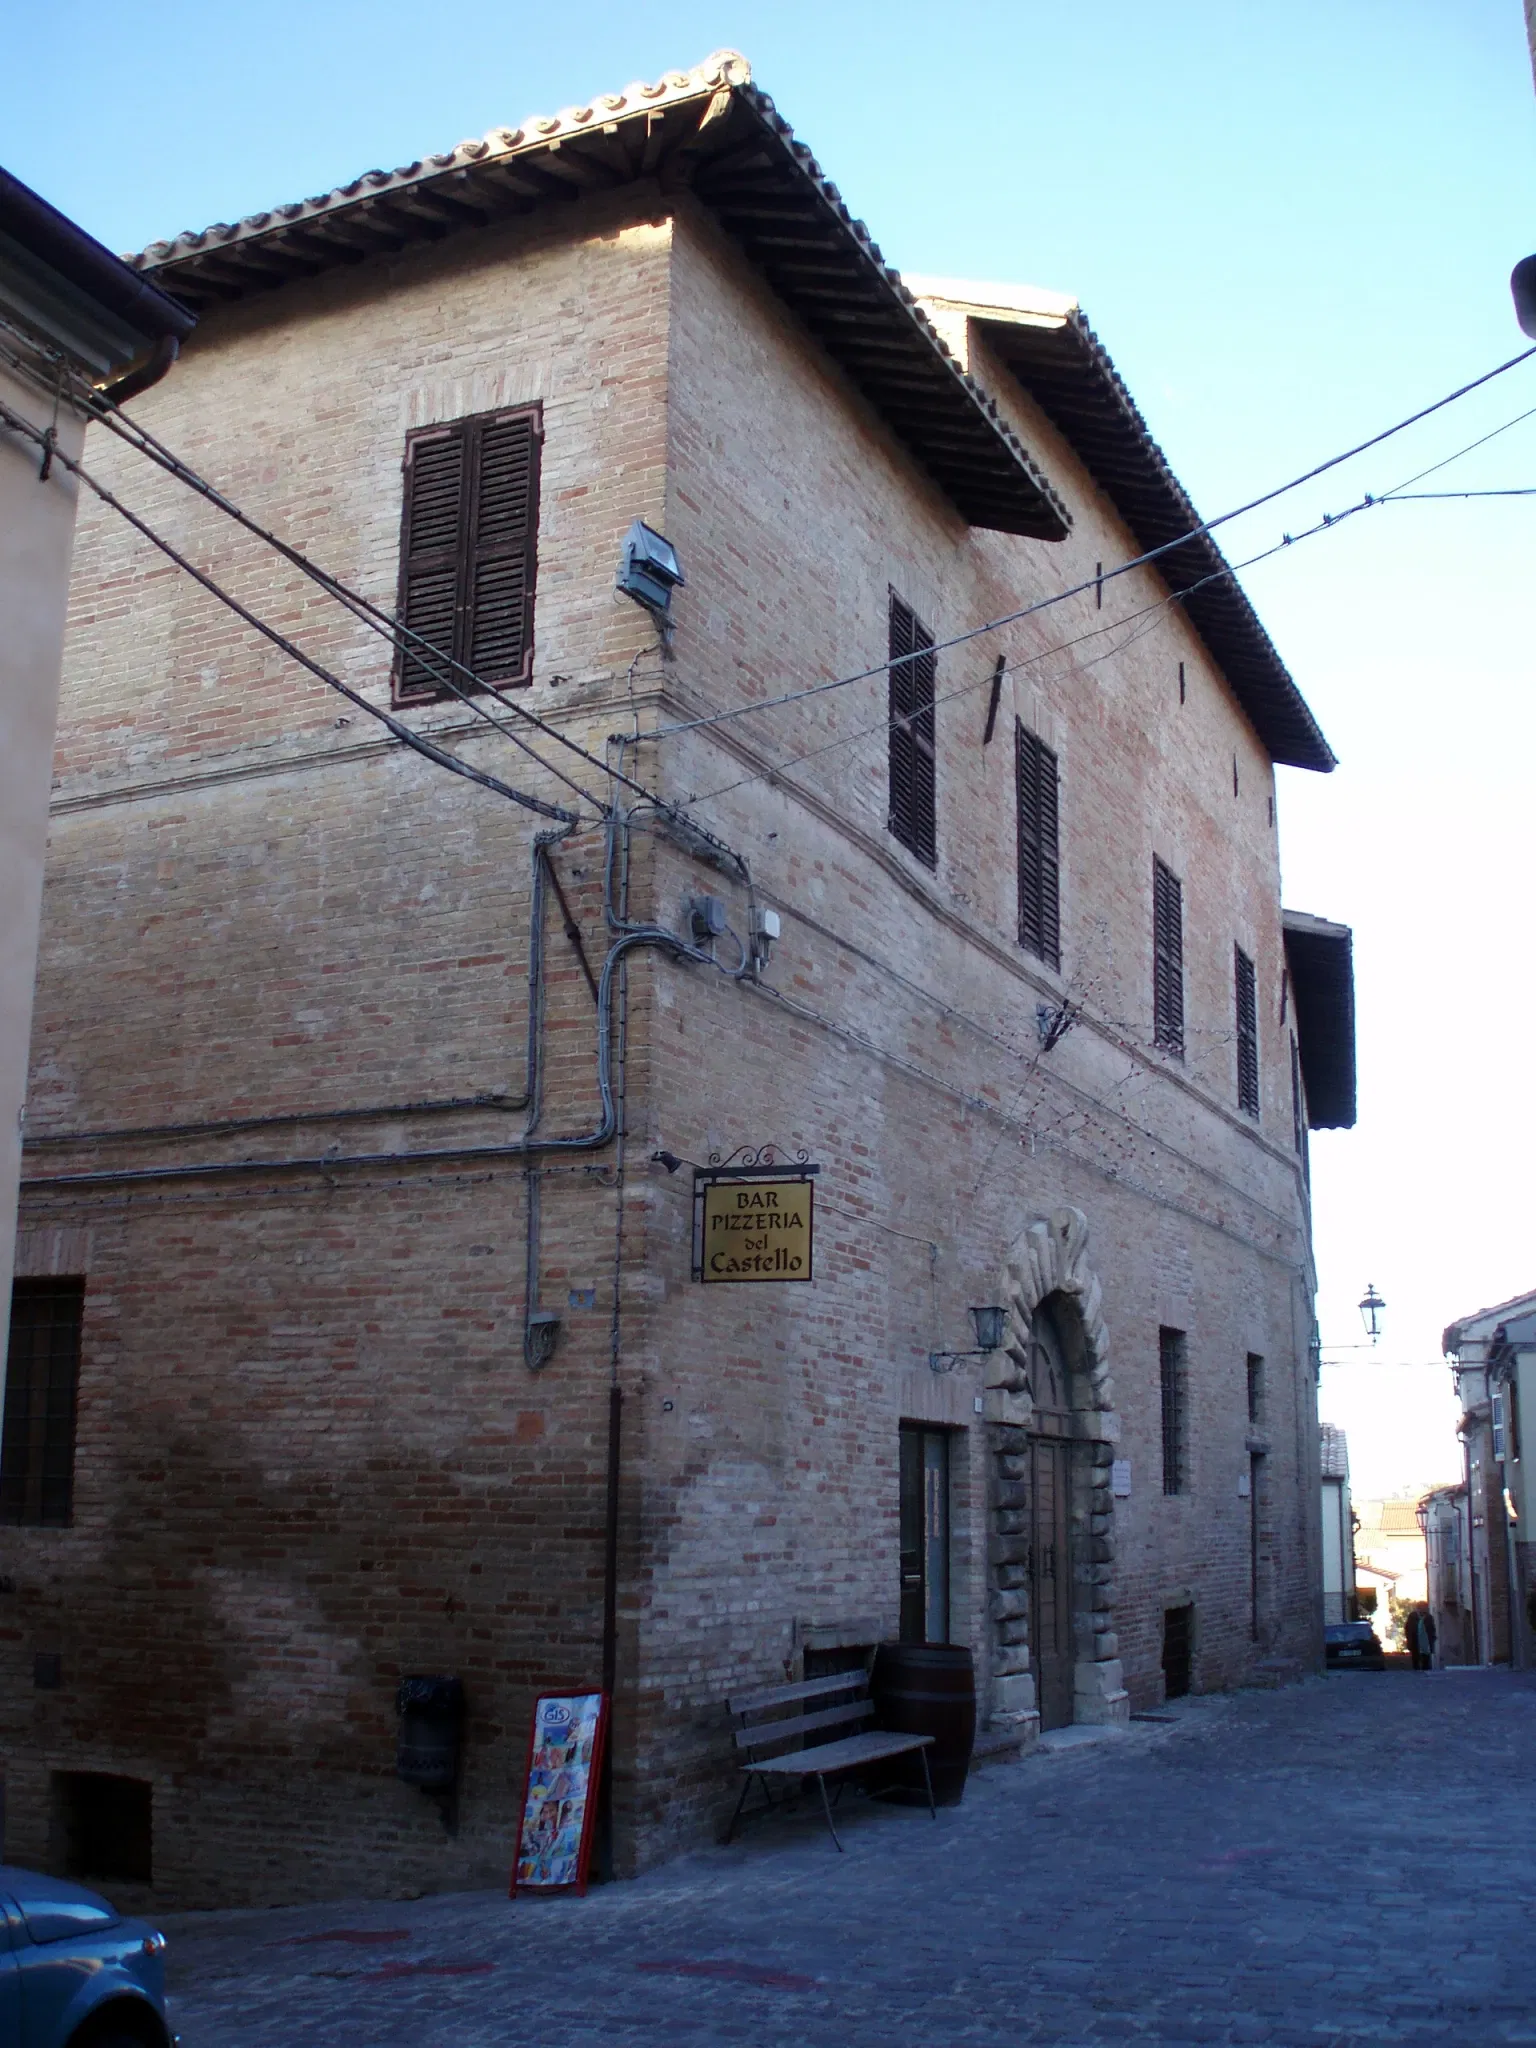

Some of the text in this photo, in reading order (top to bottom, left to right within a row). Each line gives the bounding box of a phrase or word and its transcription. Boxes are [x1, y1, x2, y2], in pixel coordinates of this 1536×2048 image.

[736, 1191, 779, 1209] BAR
[711, 1212, 804, 1231] PIZZERIA
[744, 1234, 768, 1250] del
[710, 1247, 803, 1273] Castello
[544, 1709, 565, 1721] GIS
